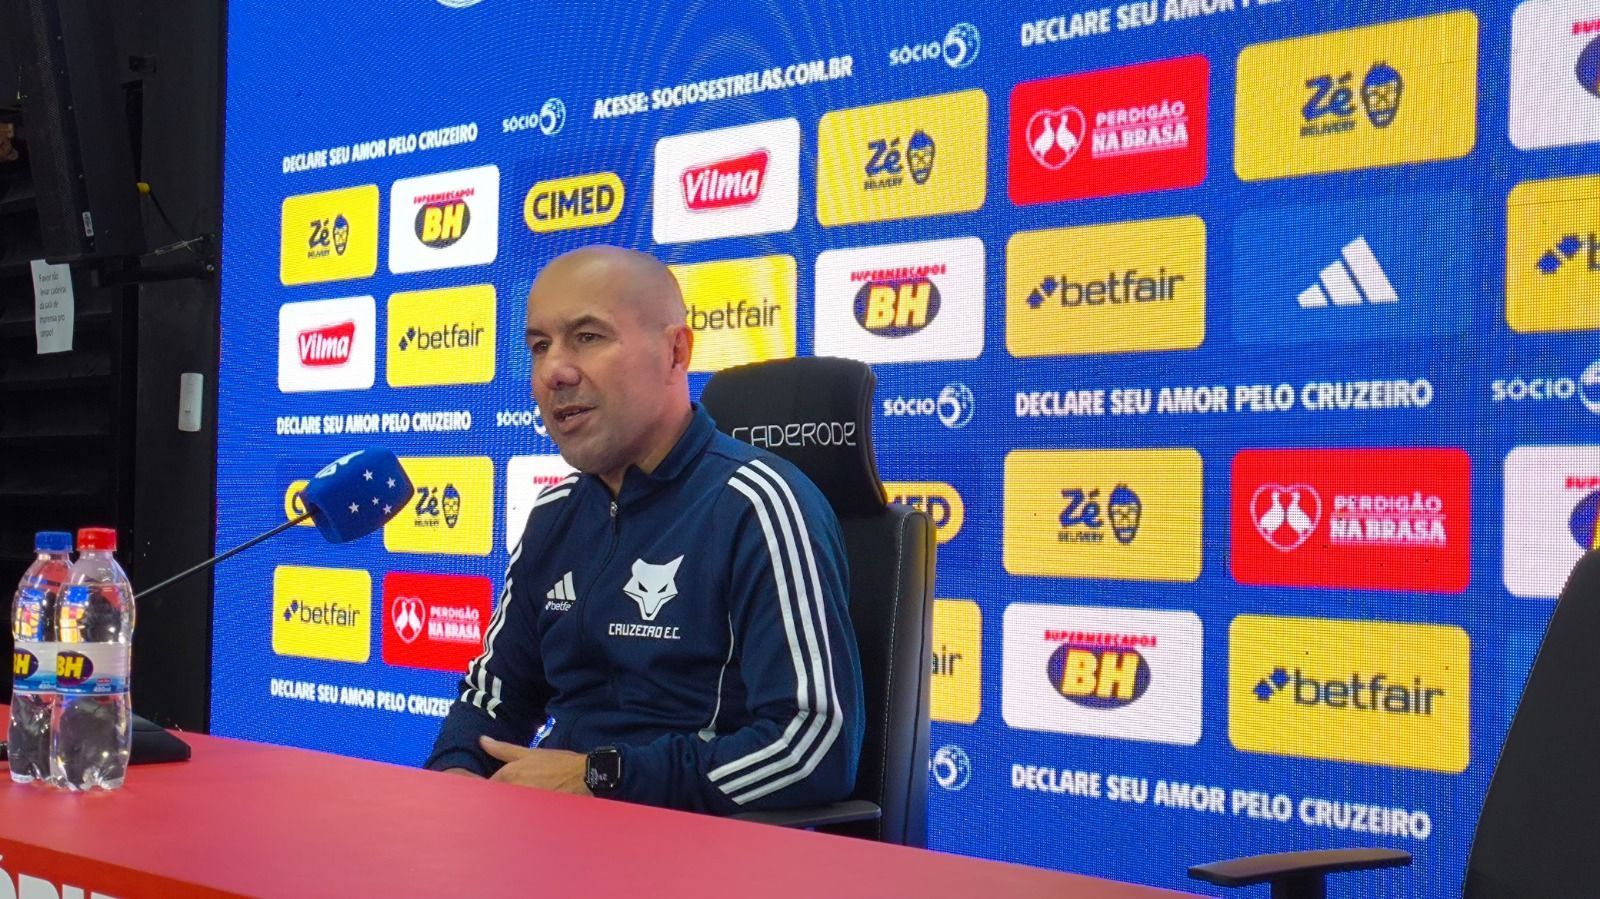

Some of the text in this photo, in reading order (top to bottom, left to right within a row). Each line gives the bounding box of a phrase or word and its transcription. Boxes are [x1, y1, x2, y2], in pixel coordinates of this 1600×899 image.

[1020, 8, 1110, 47] DECLARE
[1116, 0, 1158, 30] SEU
[593, 92, 648, 119] ACESSE:
[1096, 99, 1186, 127] PERDIGÃO
[1302, 71, 1356, 121] Zé
[282, 122, 478, 174] DECLARE SEU AMOR PELO CRUZEIRO
[864, 137, 904, 175] Zé
[1092, 122, 1188, 153] NA BRASA
[532, 184, 614, 220] CIMED
[686, 163, 759, 204] Vilma
[308, 215, 330, 248] Zé
[422, 202, 467, 242] BH
[866, 282, 930, 329] BH
[1060, 268, 1184, 307] betfair
[692, 298, 781, 330] betfair
[300, 333, 349, 360] Vilma
[418, 323, 484, 350] betfair
[1016, 378, 1433, 417] DECLARE SEU AMOR PELO CRUZEIRO
[276, 410, 472, 435] DECLARE SEU AMOR PELO CRUZEIRO
[414, 486, 440, 517] Zé
[1058, 488, 1104, 528] Zé
[1334, 491, 1442, 513] PERDIGÃO
[1330, 519, 1446, 545] NA BRASA
[300, 600, 360, 627] betfair
[608, 624, 662, 638] CRUZEIRO
[1062, 648, 1140, 700] BH
[1294, 669, 1445, 716] betfair
[270, 678, 454, 718] DECLARE SEU AMOR PELO CRUZEI
[1012, 764, 1431, 841] DECLARE SEU AMOR PELO CRUZEIRO
